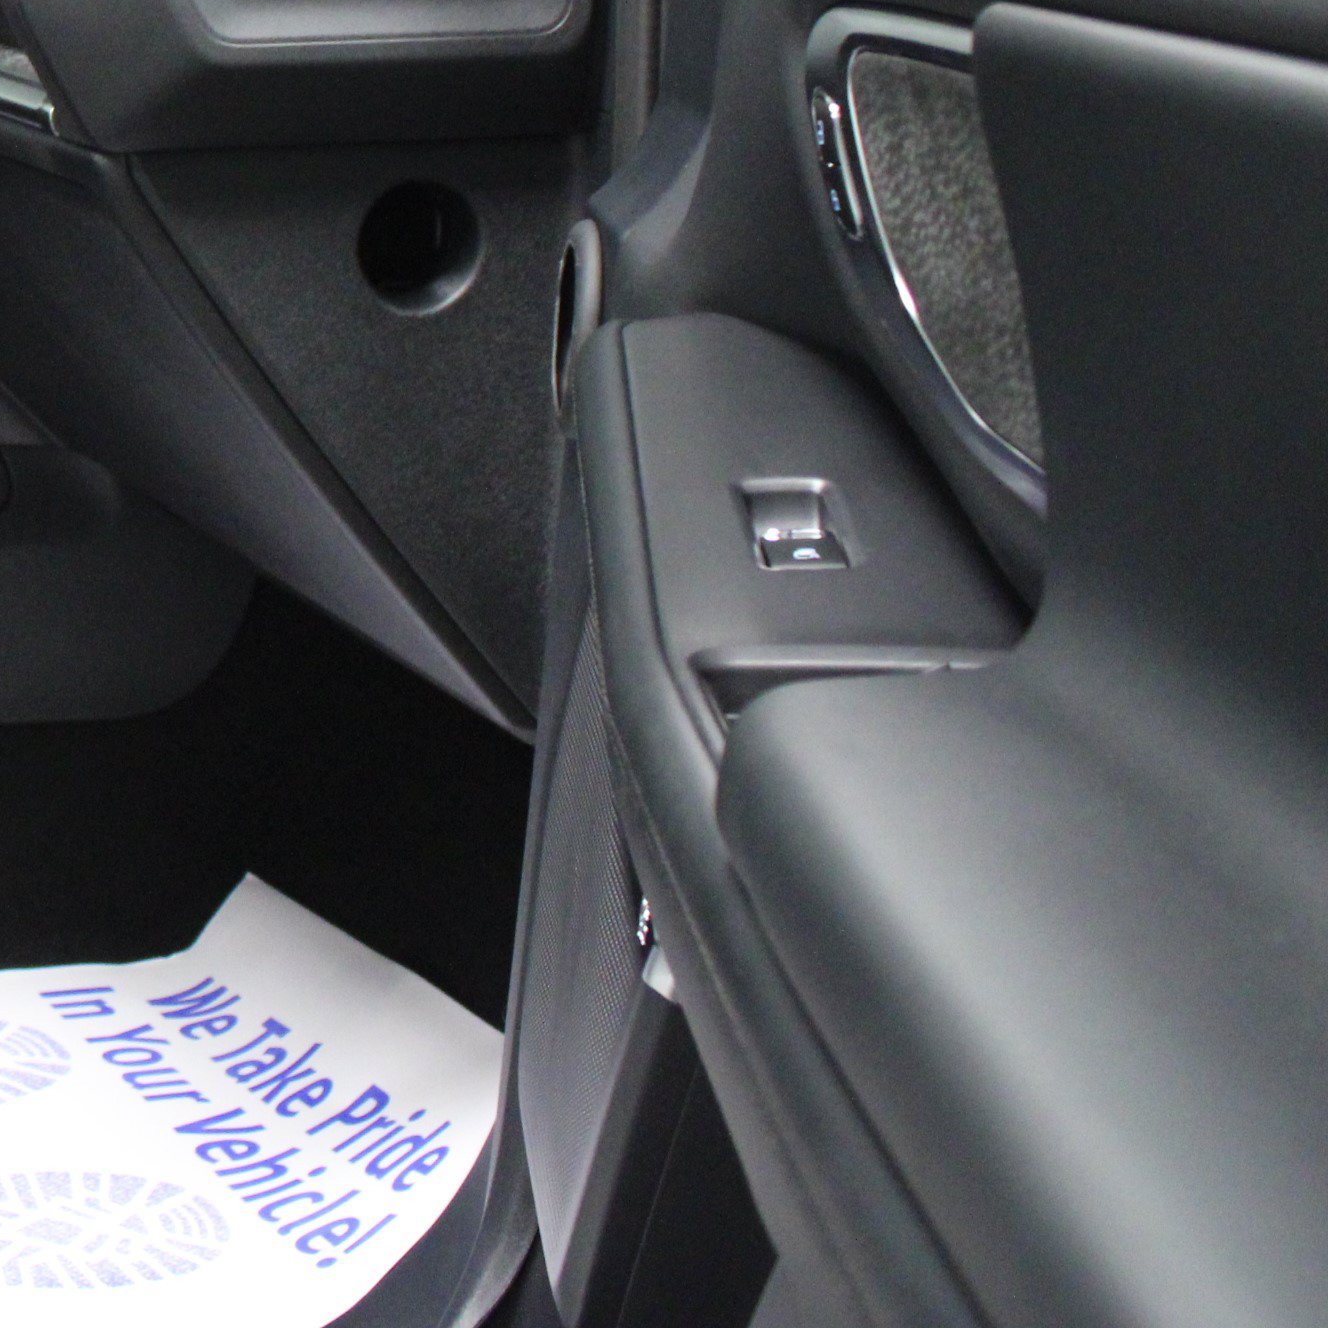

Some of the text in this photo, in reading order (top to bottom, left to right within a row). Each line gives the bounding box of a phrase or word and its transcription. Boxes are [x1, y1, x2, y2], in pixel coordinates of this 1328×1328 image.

[39, 986, 398, 1269] In Your Vehicle!
[148, 977, 451, 1192] We Take Pride
